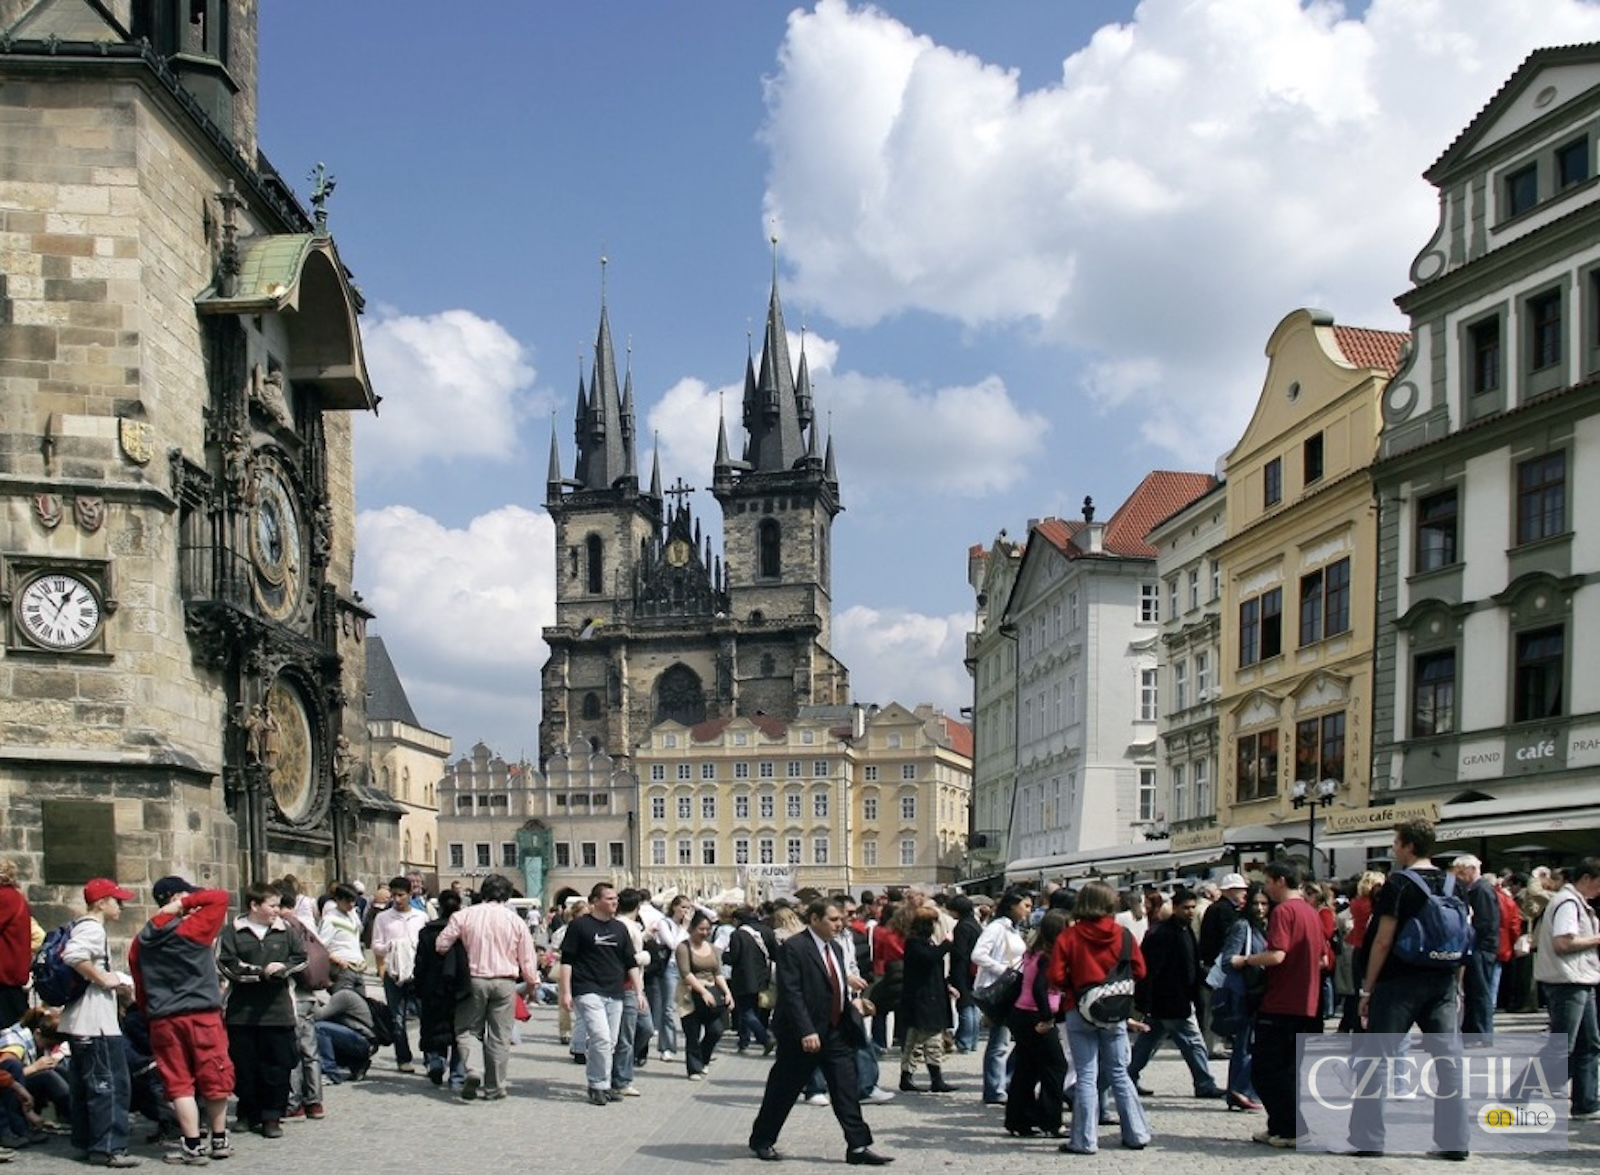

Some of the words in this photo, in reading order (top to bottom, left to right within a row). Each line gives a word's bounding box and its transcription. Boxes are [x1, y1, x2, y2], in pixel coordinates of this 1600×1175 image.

[1352, 697, 1360, 778] PRAHA
[1463, 752, 1500, 766] GRAND
[1516, 740, 1555, 760] café
[1338, 815, 1367, 826] GRAND
[1369, 809, 1393, 823] café
[1395, 808, 1427, 819] PRAHA
